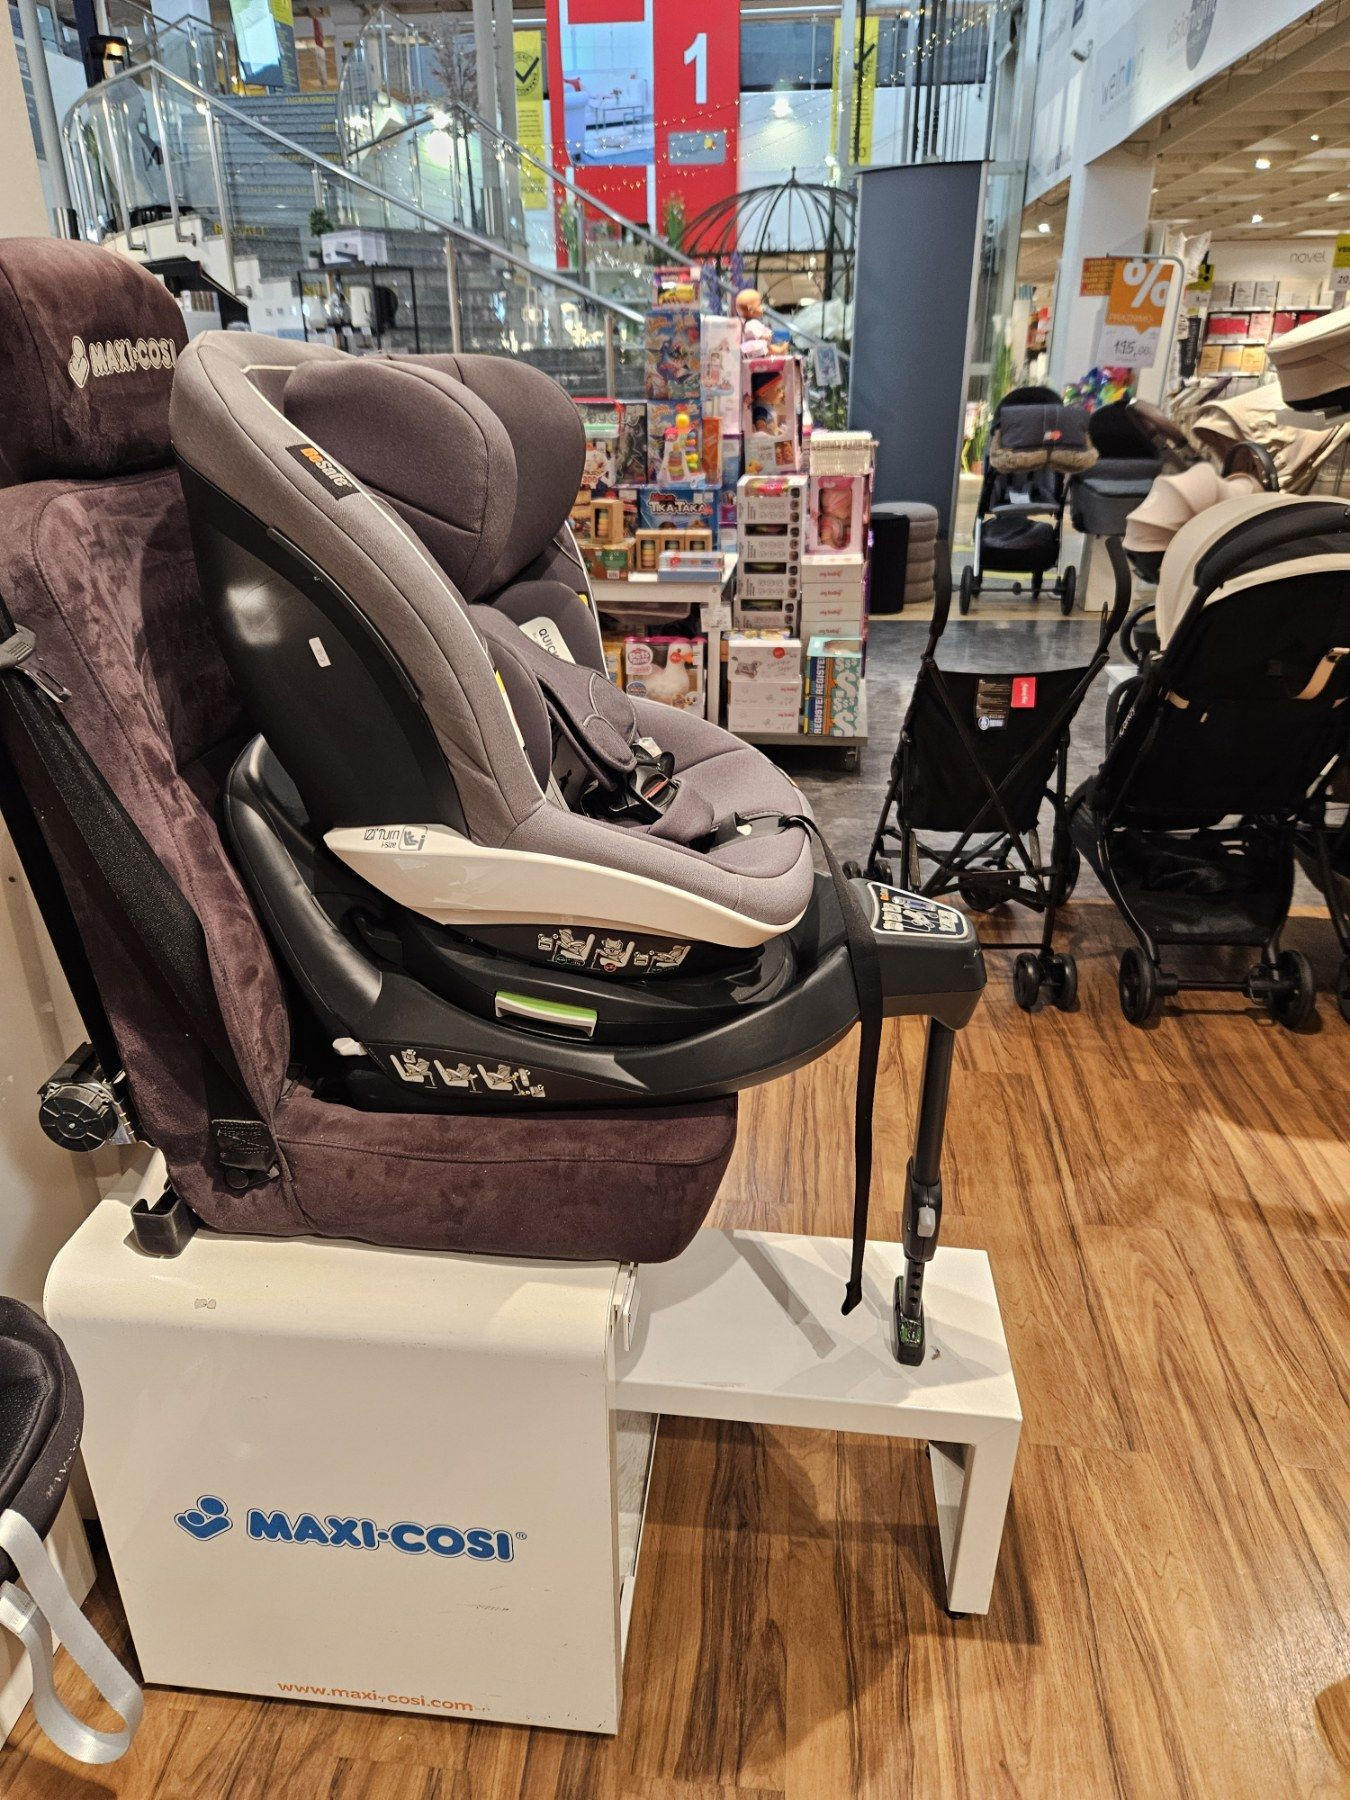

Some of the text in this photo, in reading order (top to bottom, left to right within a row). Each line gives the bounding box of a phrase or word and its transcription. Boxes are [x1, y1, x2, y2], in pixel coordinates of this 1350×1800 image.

[683, 32, 708, 104] 1
[1289, 250, 1326, 263] novel
[816, 656, 826, 695] REGISTE
[813, 695, 824, 734] REGISTE
[277, 1682, 474, 1711] www.maxi-cosi.com
